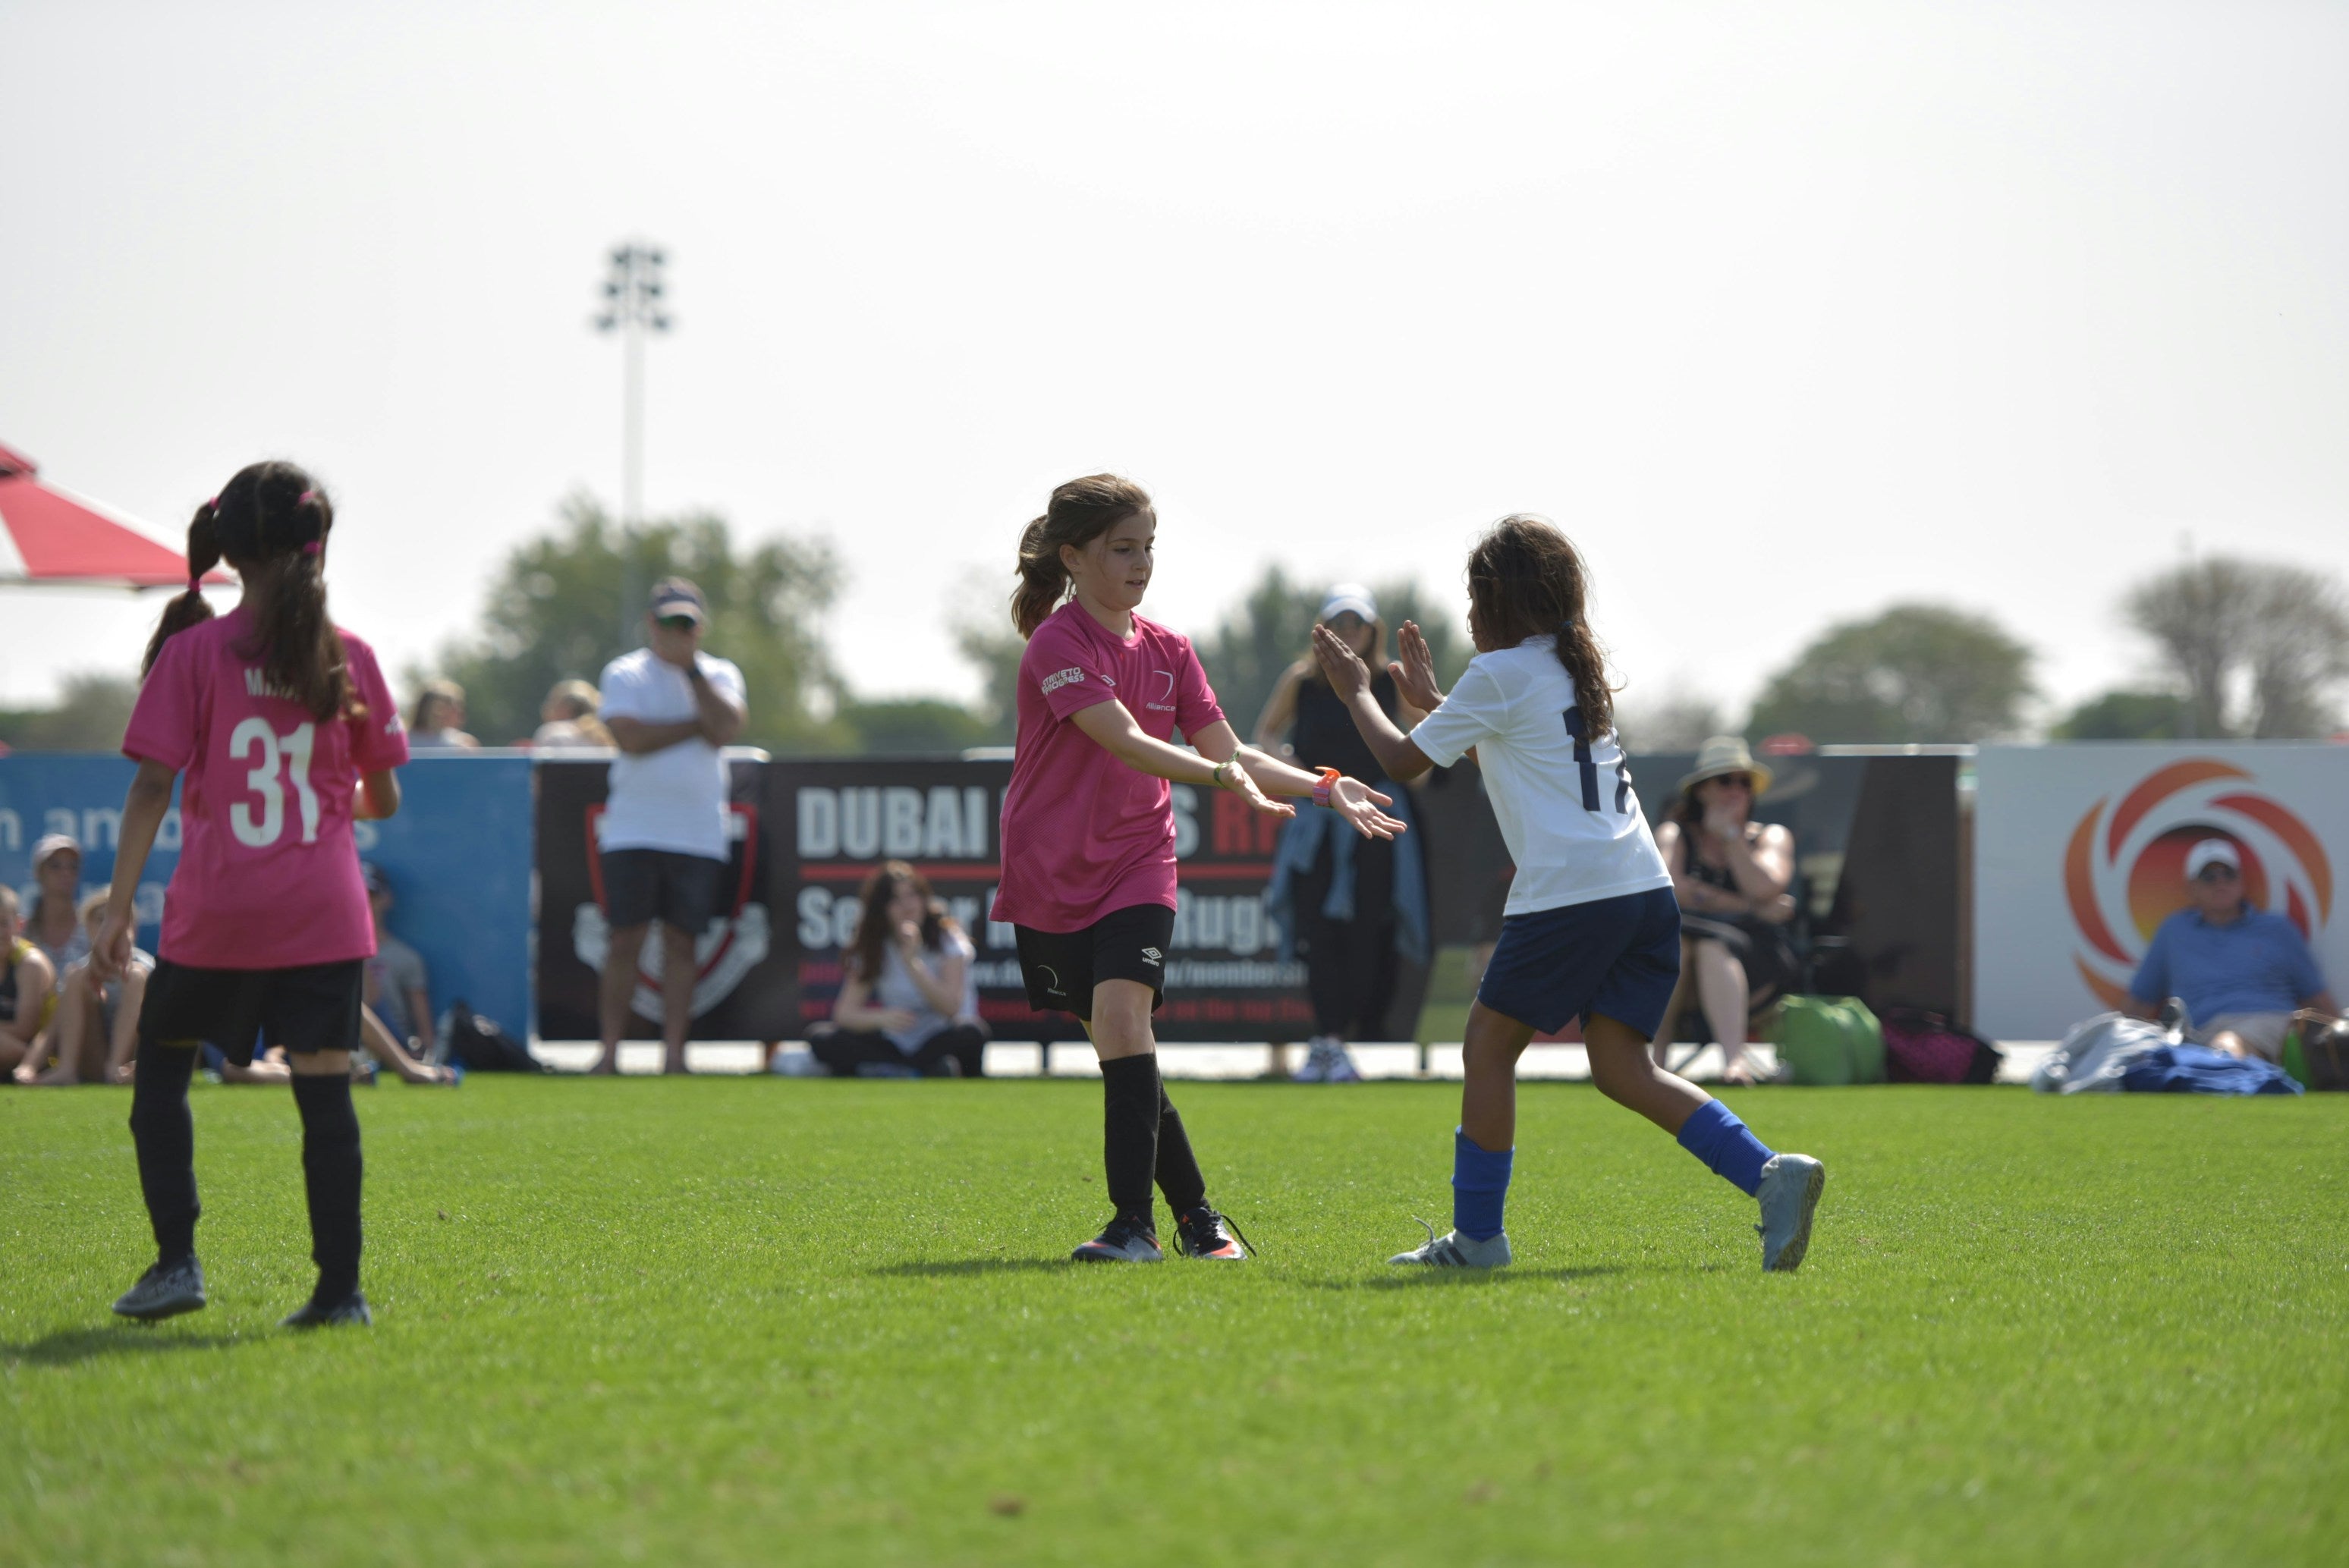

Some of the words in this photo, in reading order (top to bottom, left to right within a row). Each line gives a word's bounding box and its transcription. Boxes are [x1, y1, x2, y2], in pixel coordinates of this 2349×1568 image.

[1145, 702, 1176, 712] Alliance
[229, 717, 320, 847] 31
[797, 786, 989, 859] DUBAI
[1142, 957, 1160, 967] umbro
